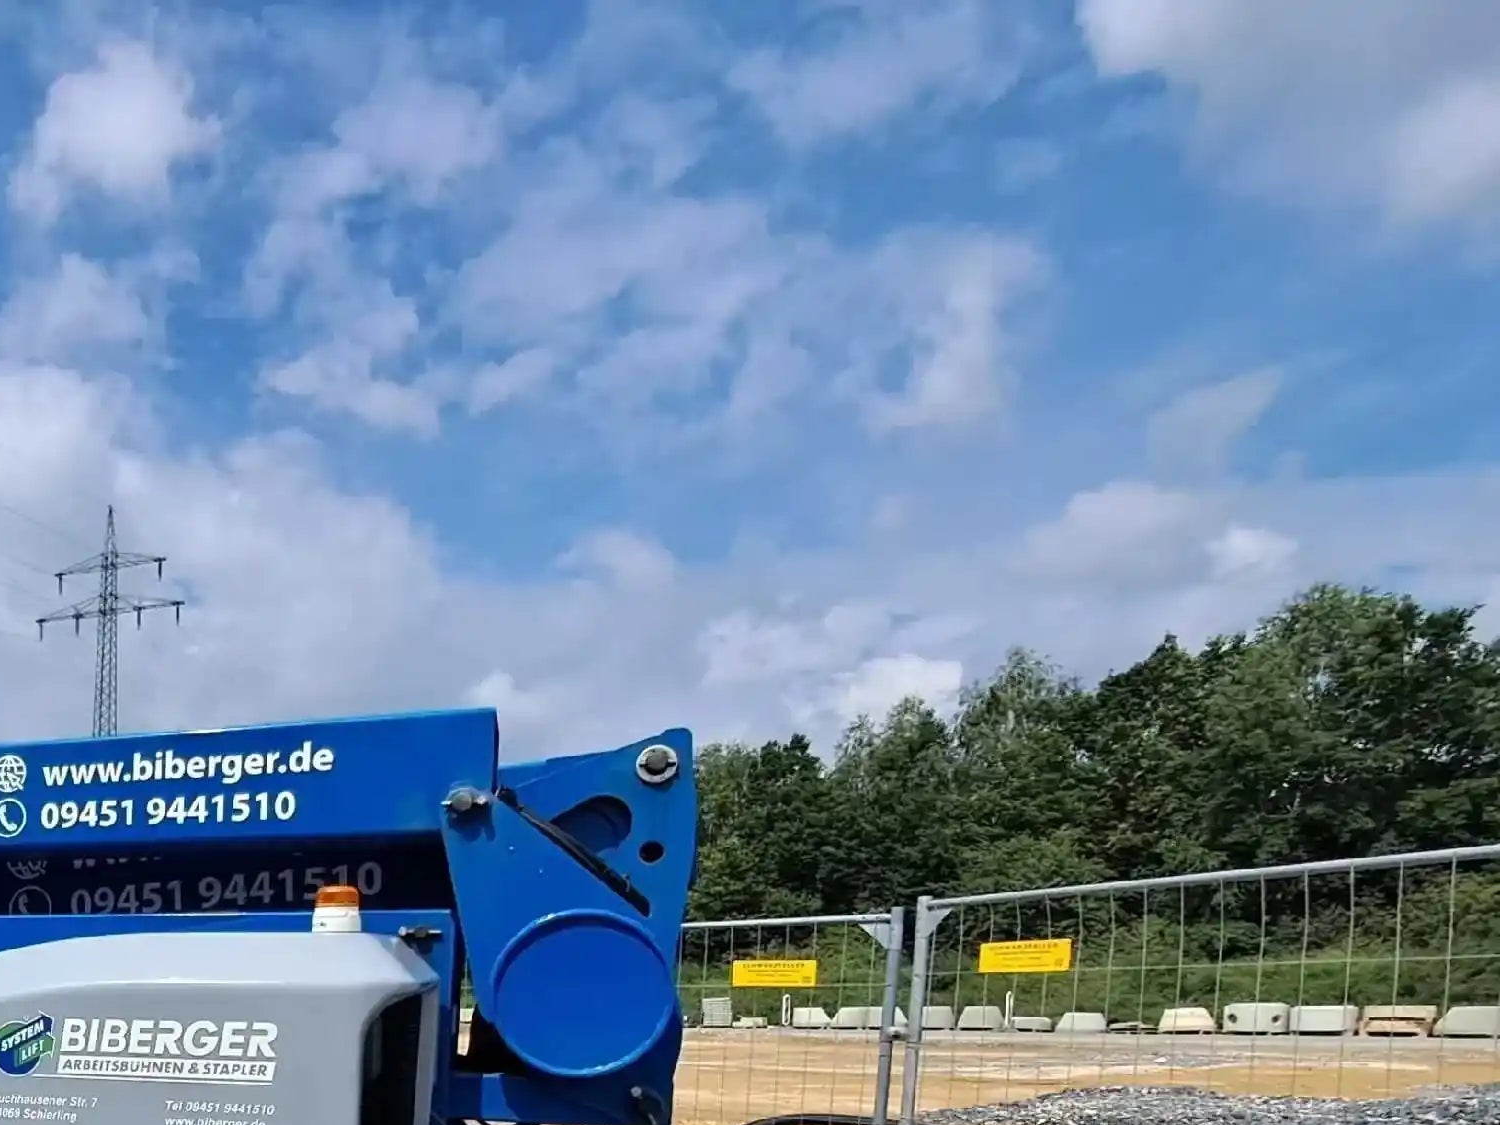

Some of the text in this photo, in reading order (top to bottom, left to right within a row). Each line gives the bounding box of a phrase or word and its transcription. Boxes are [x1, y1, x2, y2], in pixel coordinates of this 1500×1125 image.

[42, 741, 335, 787] www.biberger.de
[40, 791, 297, 829] 09451 9441510
[70, 862, 382, 914] 09451 9441510
[1, 1020, 44, 1052] SYSTEM
[21, 1039, 44, 1061] LIFT
[60, 1018, 278, 1058] BIBERGER
[188, 1062, 199, 1074] &
[202, 1063, 267, 1077] STAPLER
[91, 1097, 99, 1107] 7
[224, 1103, 276, 1115] 9441510
